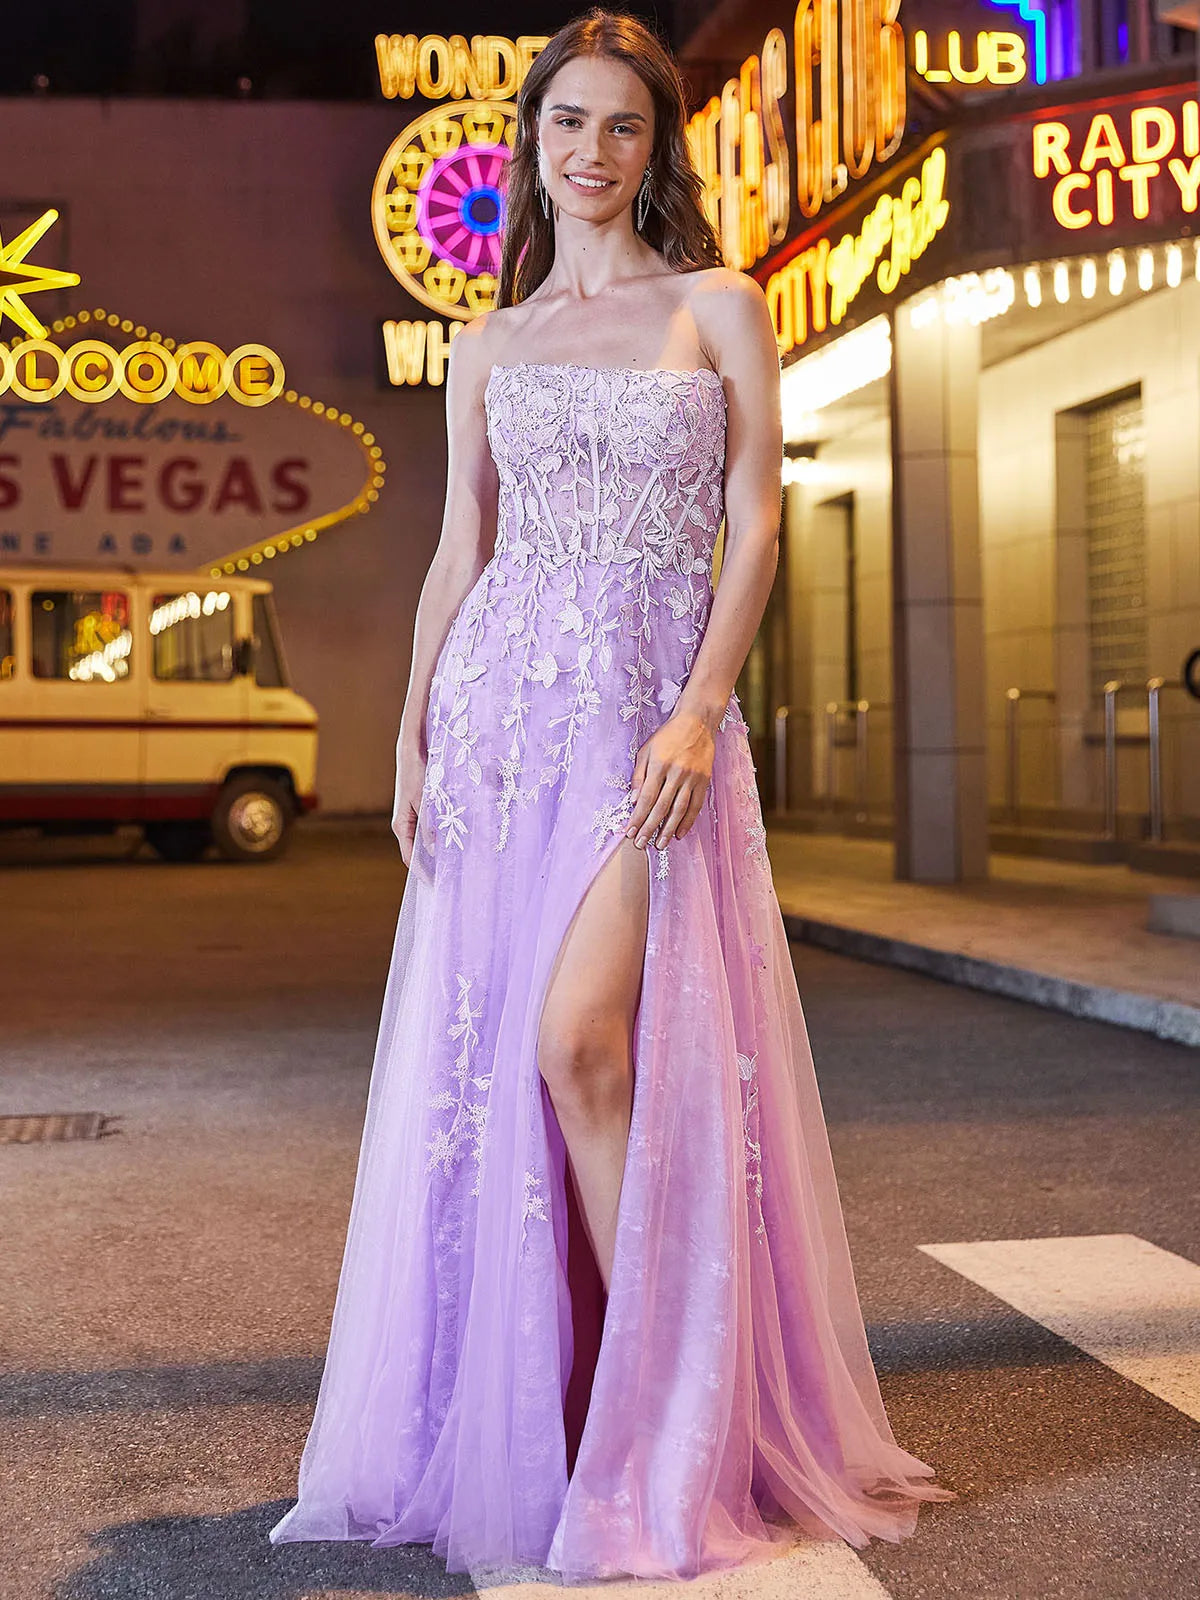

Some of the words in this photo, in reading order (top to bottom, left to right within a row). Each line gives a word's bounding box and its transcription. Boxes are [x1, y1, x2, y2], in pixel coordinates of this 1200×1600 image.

[914, 30, 1027, 84] LUB
[1032, 100, 1199, 179] RADI
[1052, 156, 1200, 229] CITY
[50, 453, 312, 516] VEGAS
